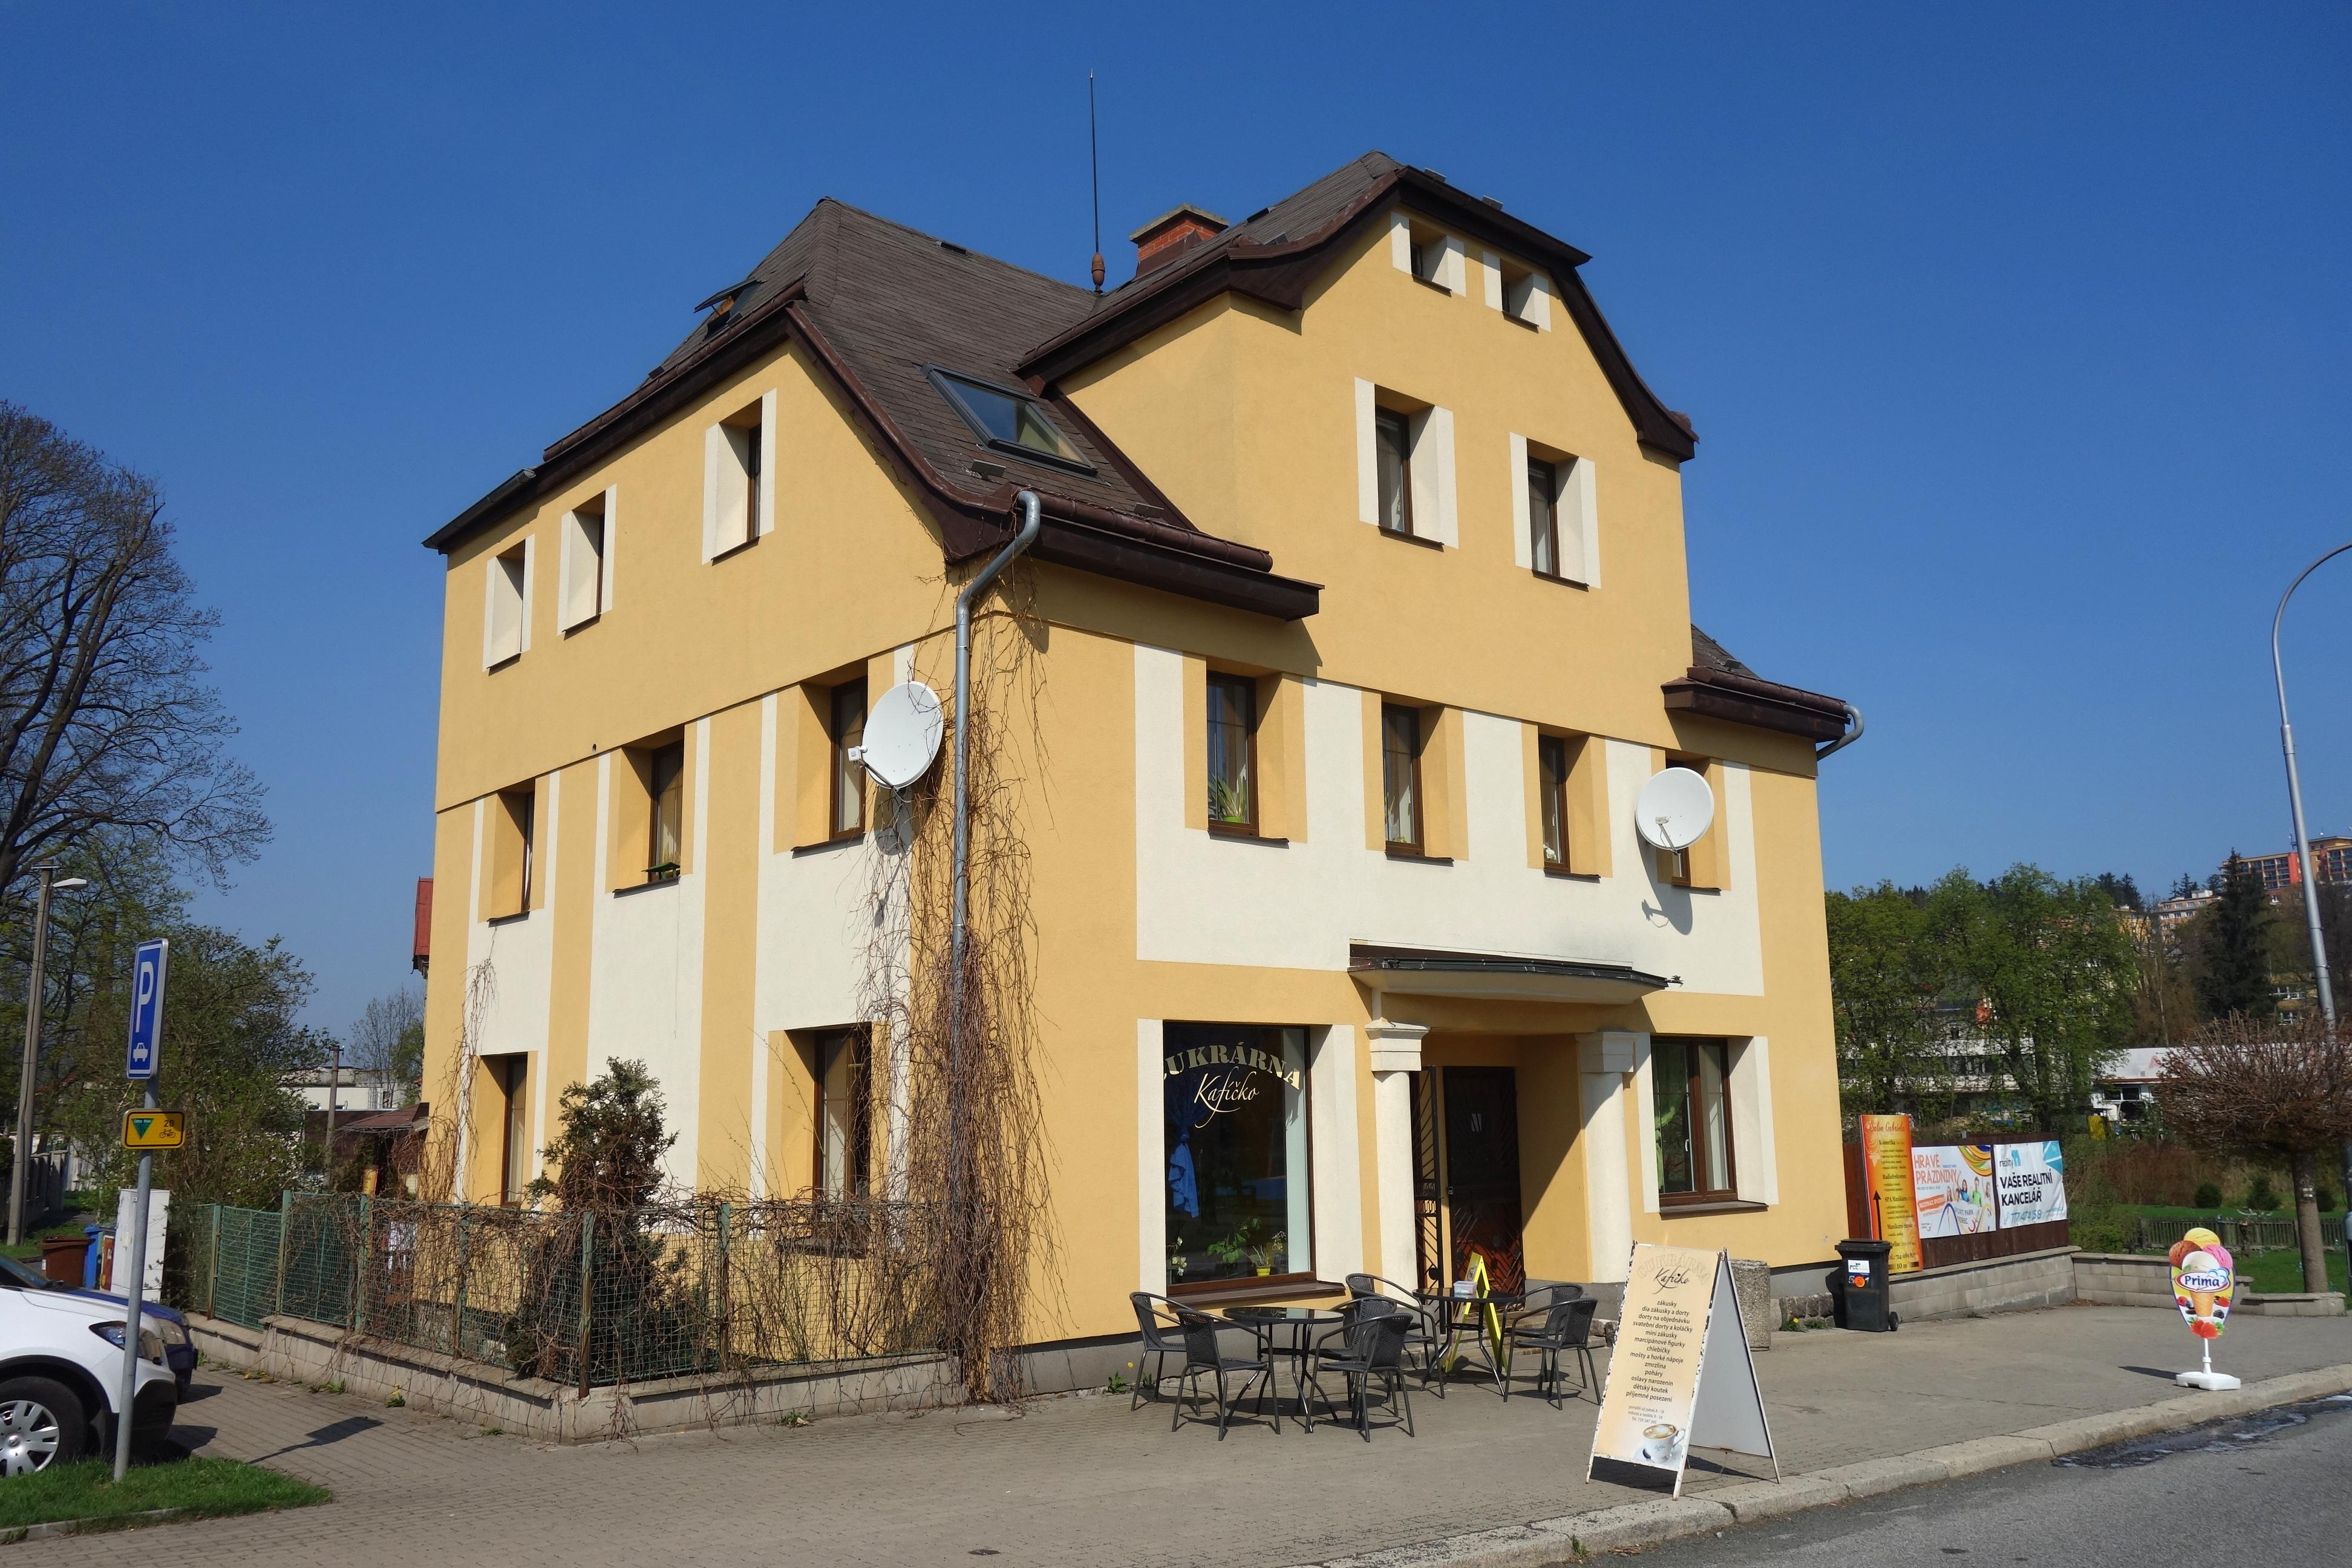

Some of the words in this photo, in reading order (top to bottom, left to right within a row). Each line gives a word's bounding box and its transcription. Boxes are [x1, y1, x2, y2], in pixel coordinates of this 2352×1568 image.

[136, 961, 154, 1033] P
[1164, 1042, 1300, 1089] UKRÁRNA
[1194, 1066, 1259, 1128] Kafíčko
[1914, 1152, 1940, 1168] HRAVÉ
[1915, 1168, 1957, 1184] PRÁZDNINY
[2000, 1172, 2022, 1189] VAŠE
[2022, 1168, 2053, 1187] REALITNÍ
[2001, 1187, 2042, 1206] KANCELÁŘ
[2184, 1275, 2220, 1287] Prima
[1660, 1316, 1690, 1324] objednávku
[1673, 1325, 1693, 1333] koláčky
[1634, 1337, 1667, 1345] marcipánové
[1667, 1340, 1685, 1348] figurky
[1647, 1346, 1671, 1354] chlebíčky
[1644, 1370, 1664, 1378] poháry
[1626, 1391, 1649, 1399] příjemné
